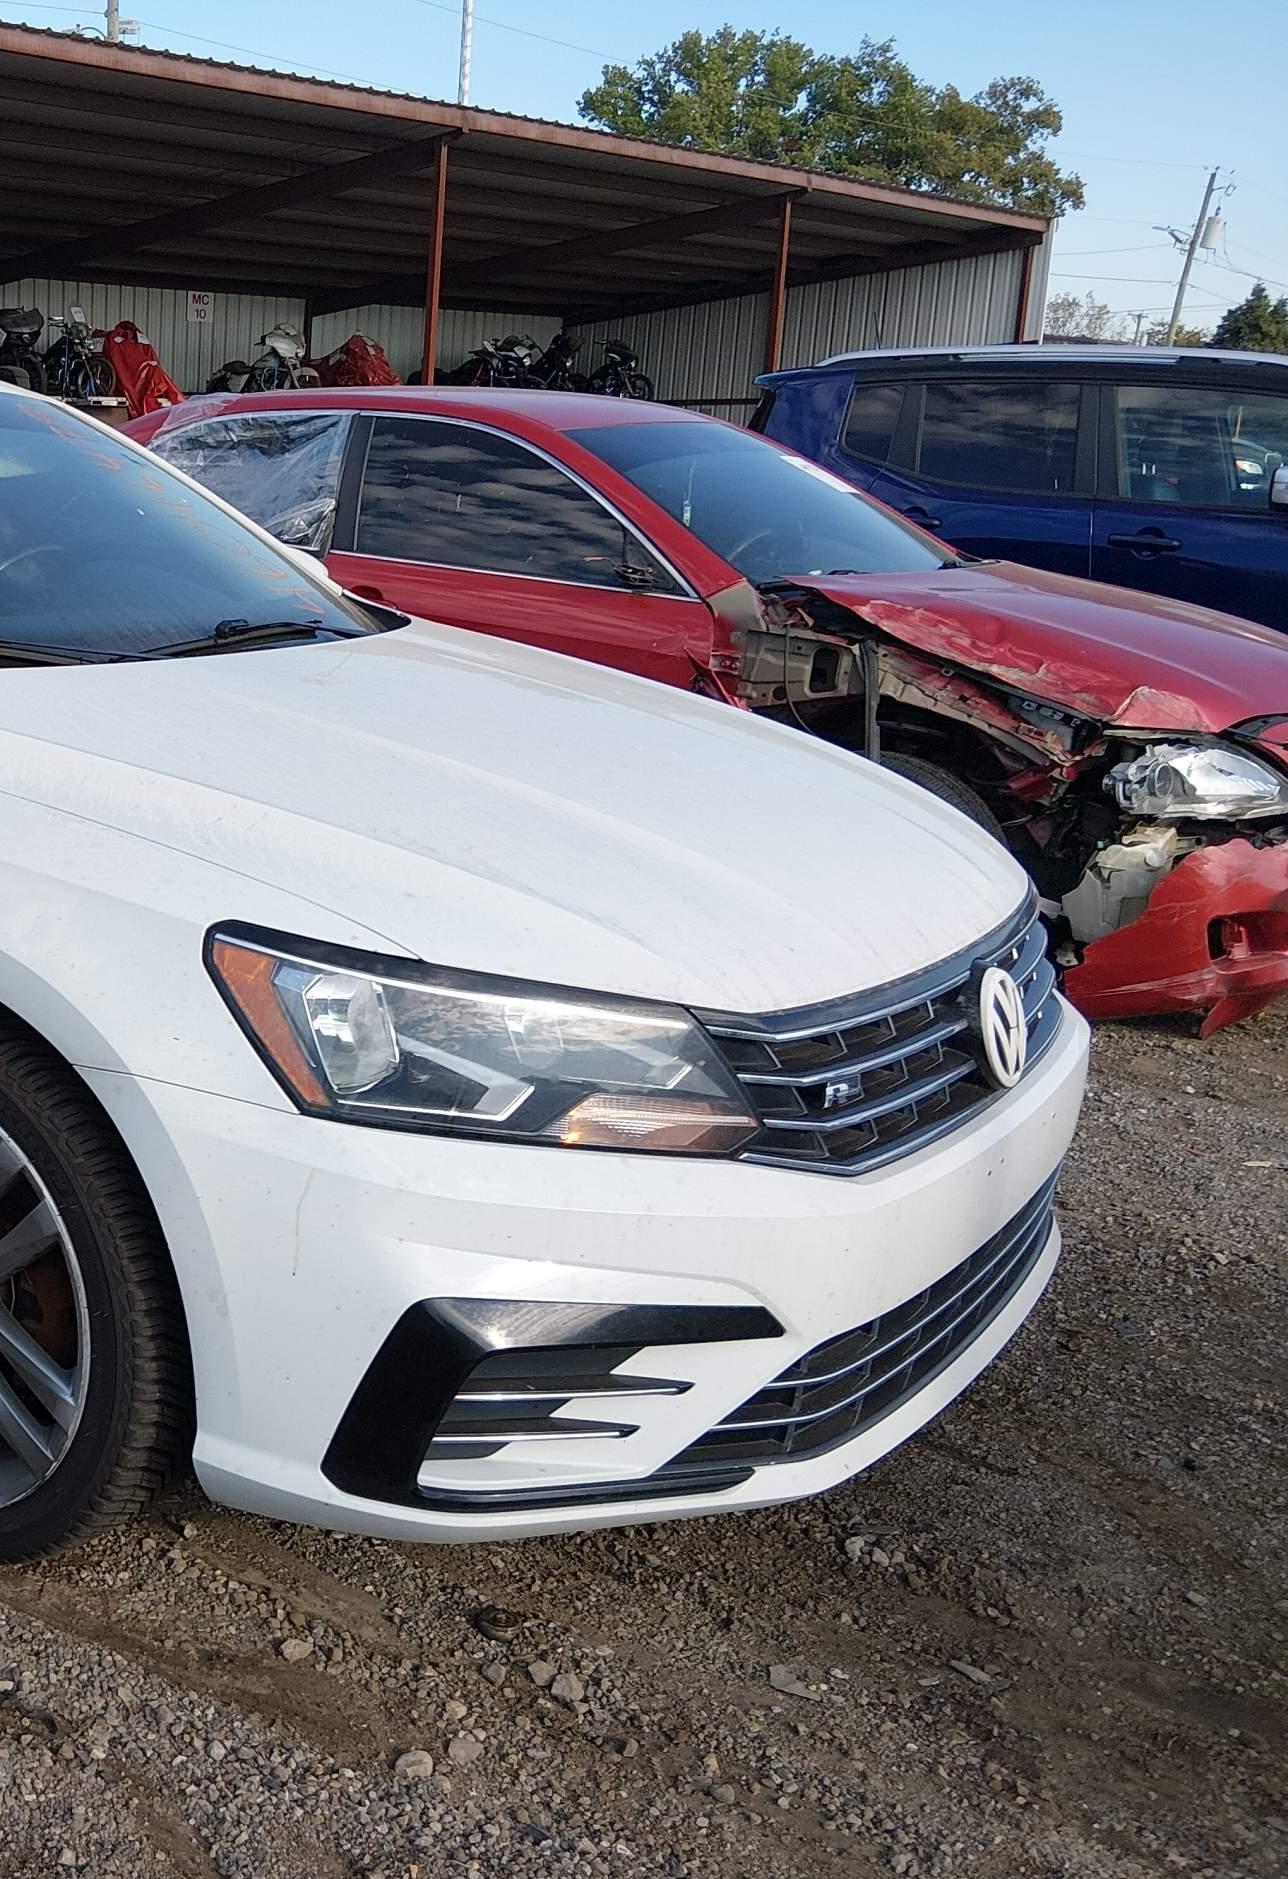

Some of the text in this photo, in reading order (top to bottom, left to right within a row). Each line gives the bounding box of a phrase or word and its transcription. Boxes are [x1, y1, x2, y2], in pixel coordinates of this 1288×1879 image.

[192, 293, 210, 306] MC
[195, 308, 207, 320] 10
[824, 1083, 849, 1109] R
